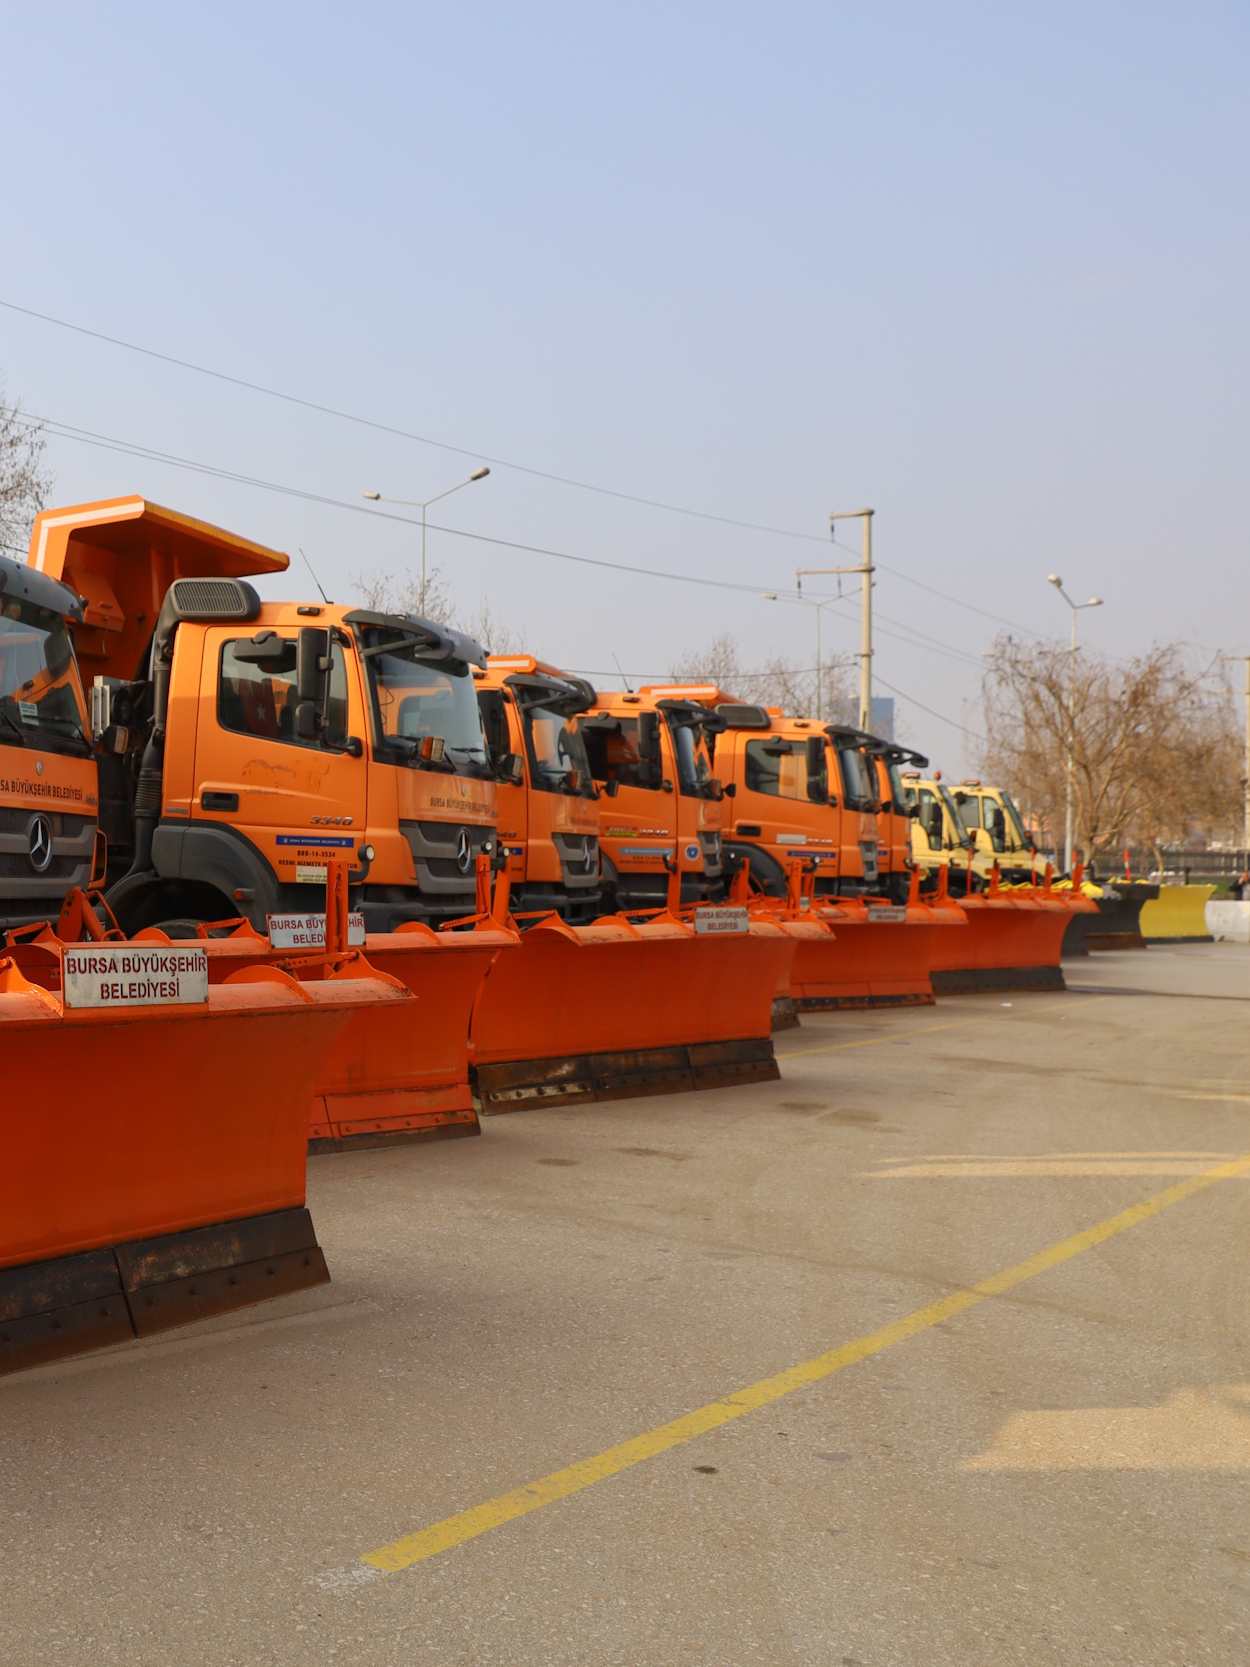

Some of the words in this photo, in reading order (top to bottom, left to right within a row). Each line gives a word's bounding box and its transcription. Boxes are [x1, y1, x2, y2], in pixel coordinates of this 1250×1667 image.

[11, 778, 52, 796] BÜYÜKŞEHİR
[52, 785, 83, 800] BELEDİYESİ
[310, 815, 353, 826] 3340
[270, 919, 304, 930] BURSA
[305, 916, 364, 929] BÜYHİR
[293, 931, 326, 944] BELEDİ
[66, 957, 118, 974] BURSA
[122, 953, 207, 976] BÜYÜKŞEHİR
[100, 978, 180, 1000] BELEDİYESİ
